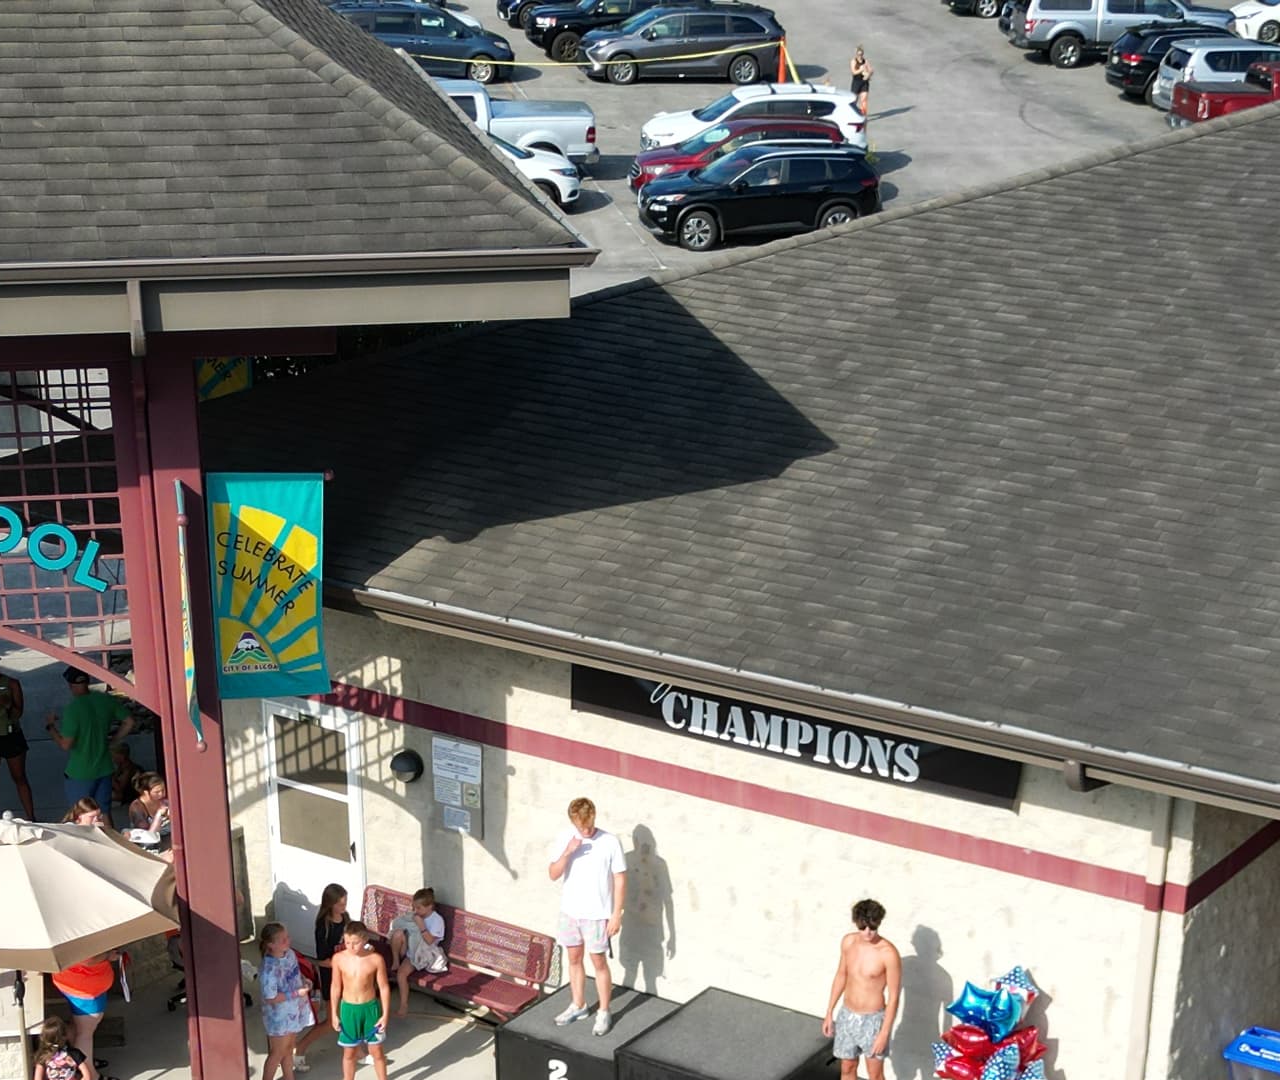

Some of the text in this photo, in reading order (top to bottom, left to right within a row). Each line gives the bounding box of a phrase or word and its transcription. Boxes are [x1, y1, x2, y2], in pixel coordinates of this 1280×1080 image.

[216, 530, 315, 595] CELEBRATE
[217, 559, 296, 617] SUMMER
[222, 662, 279, 673] CITY OF ALCOA
[660, 691, 921, 783] CHAMPIONS
